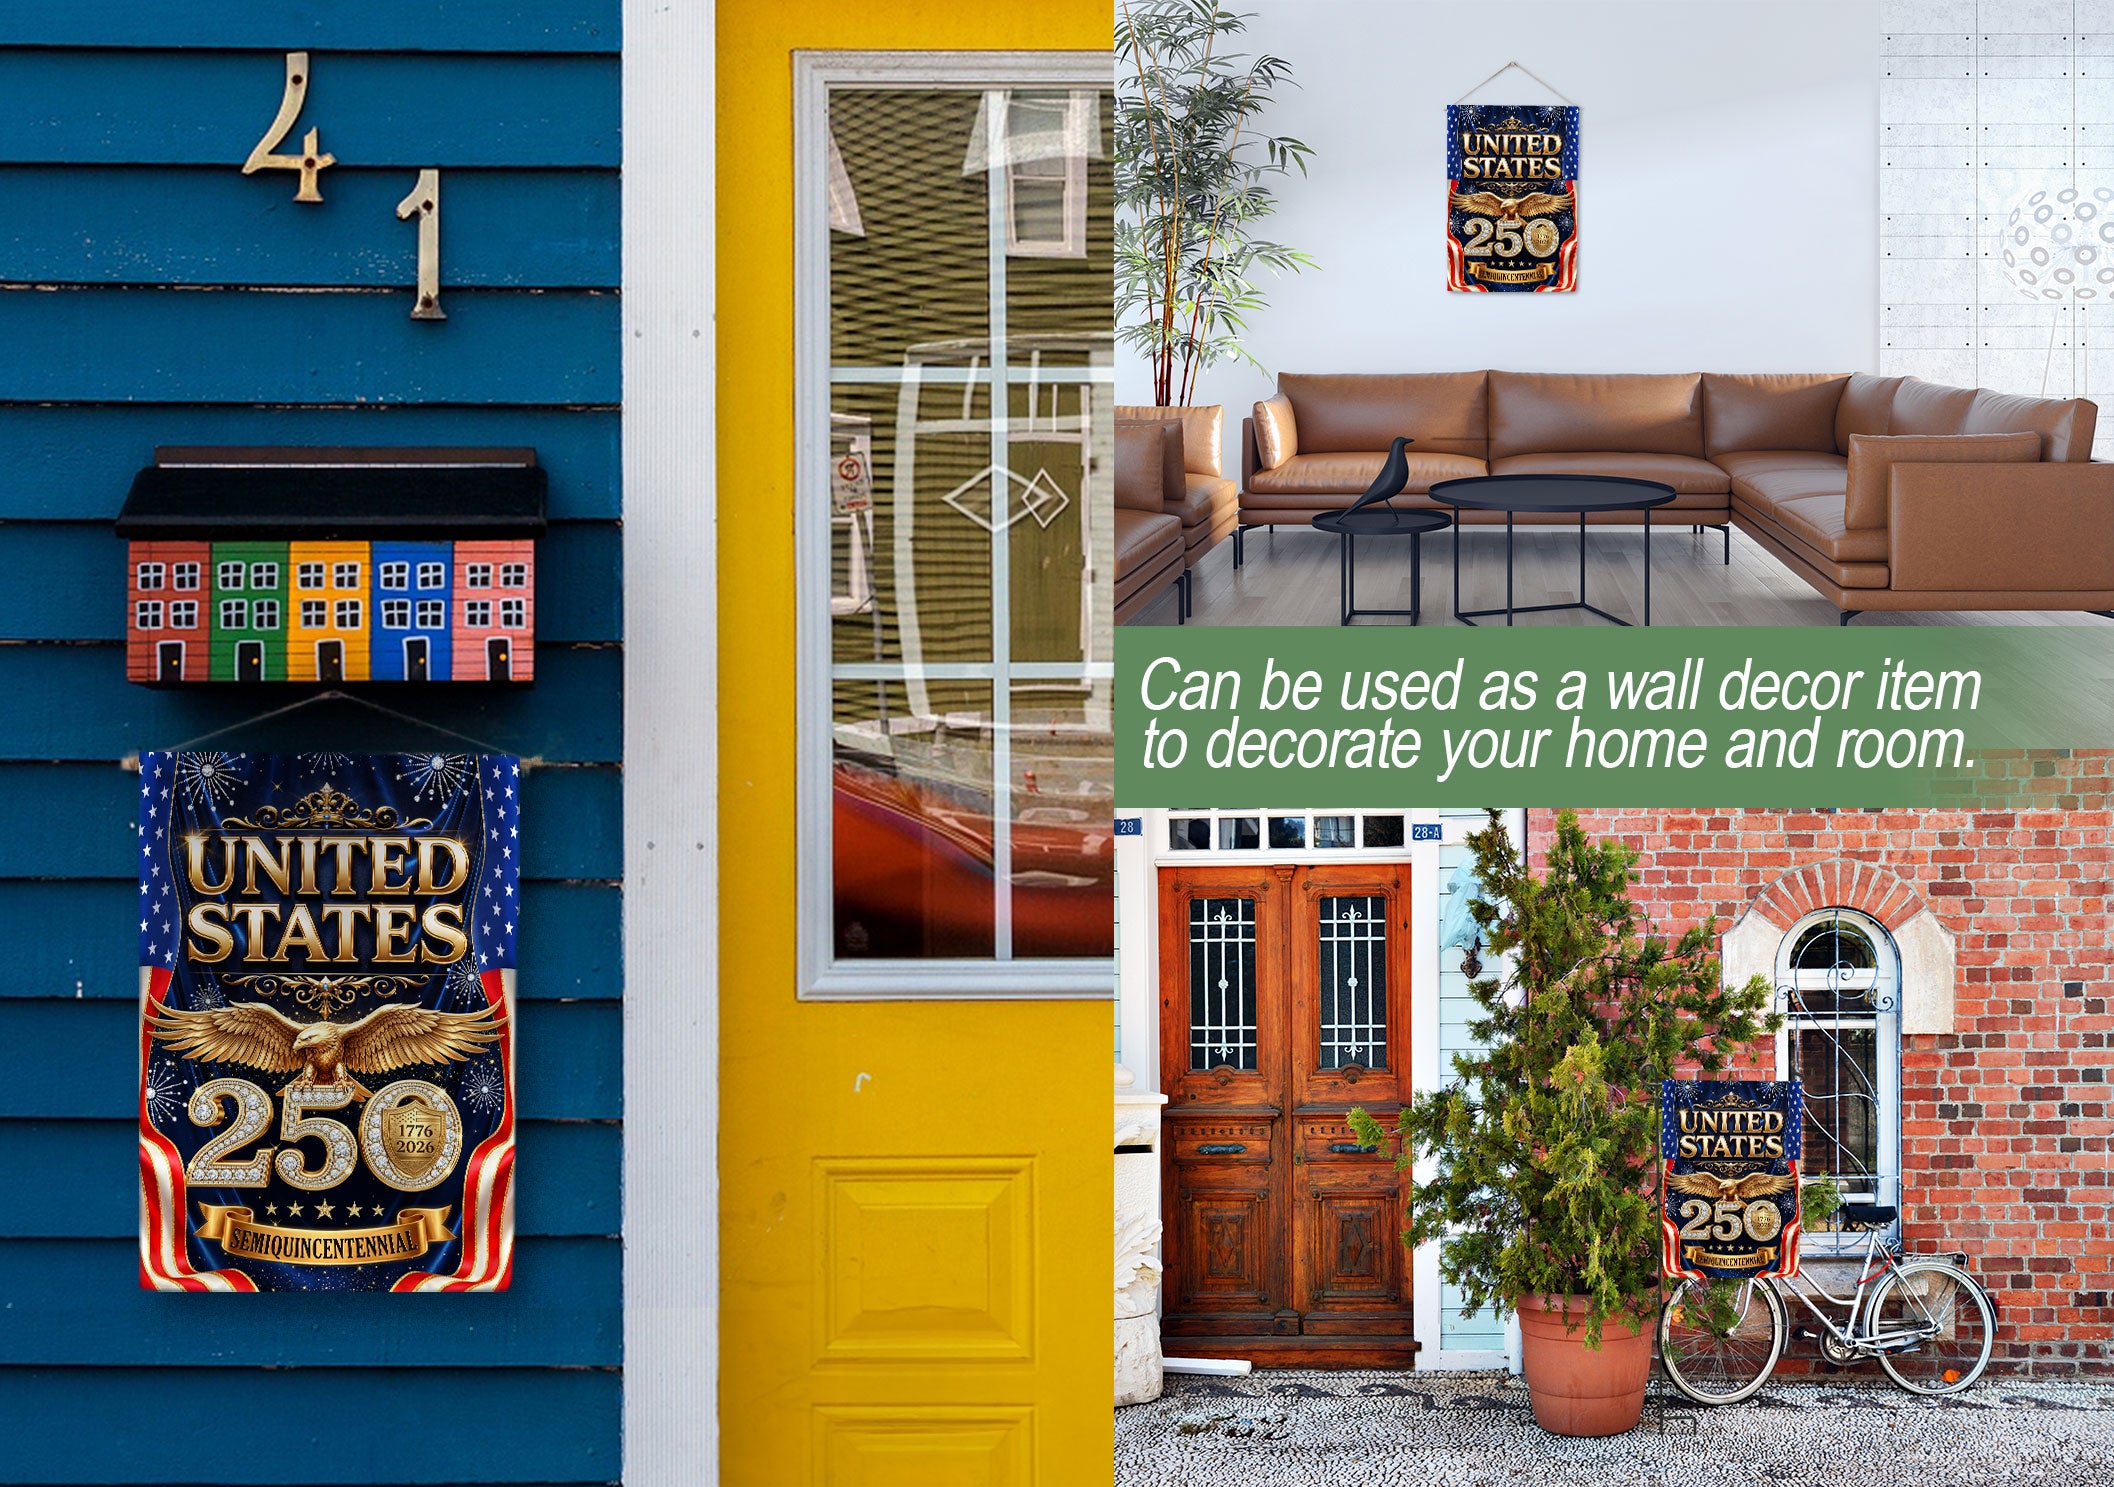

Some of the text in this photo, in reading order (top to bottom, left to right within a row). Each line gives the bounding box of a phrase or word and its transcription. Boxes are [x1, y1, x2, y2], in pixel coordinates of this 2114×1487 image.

[1462, 133, 1562, 156] UNITED
[1463, 156, 1562, 179] STATES
[1463, 217, 1560, 257] 250
[1120, 821, 1134, 833] 28
[1414, 826, 1440, 839] 28-A
[186, 835, 470, 896] UNITED
[187, 902, 469, 965] STATES
[399, 1124, 433, 1138] 1776
[1678, 1110, 1784, 1134] UNITED
[186, 1077, 463, 1192] 250
[396, 1140, 435, 1154] 2026
[1679, 1135, 1783, 1158] STATES
[1679, 1199, 1782, 1242] 250
[230, 1226, 419, 1260] SEMIQUINCENTENNIAL
